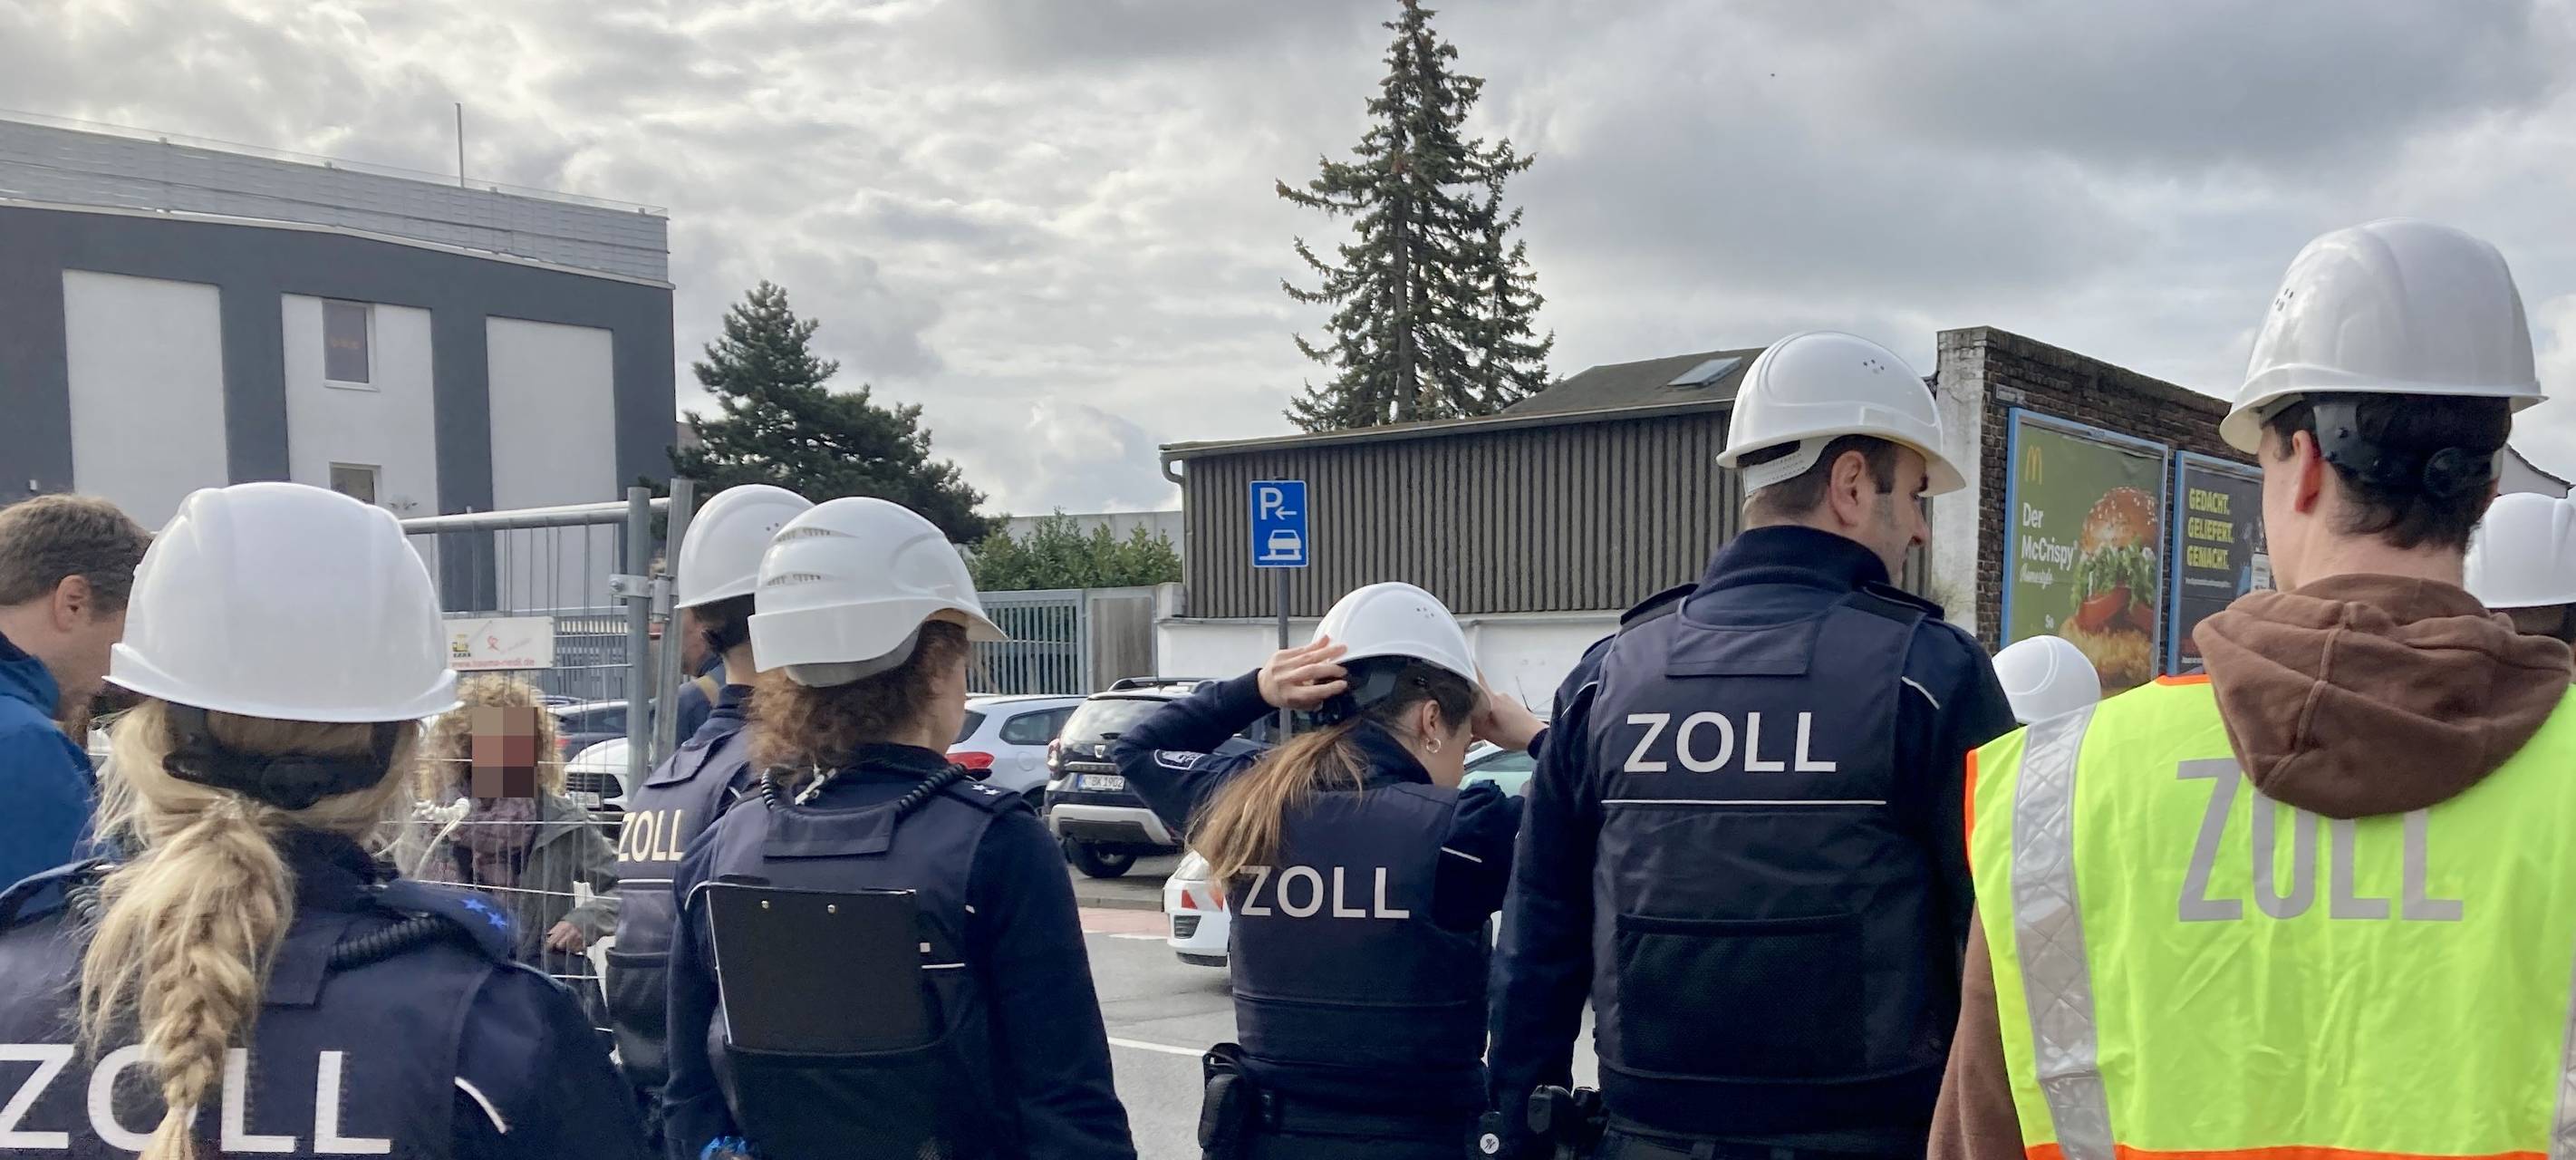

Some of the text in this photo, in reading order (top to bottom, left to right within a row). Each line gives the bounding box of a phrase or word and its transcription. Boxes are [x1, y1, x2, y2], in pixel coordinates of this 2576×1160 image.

[1259, 487, 1283, 520] P
[2022, 502, 2044, 528] Der
[1624, 711, 1837, 773] ZOLL
[618, 809, 686, 862] ZOLL
[2176, 758, 2464, 922] ZOLL
[1239, 865, 1410, 919] ZOLL
[0, 1043, 392, 1155] ZOLL
